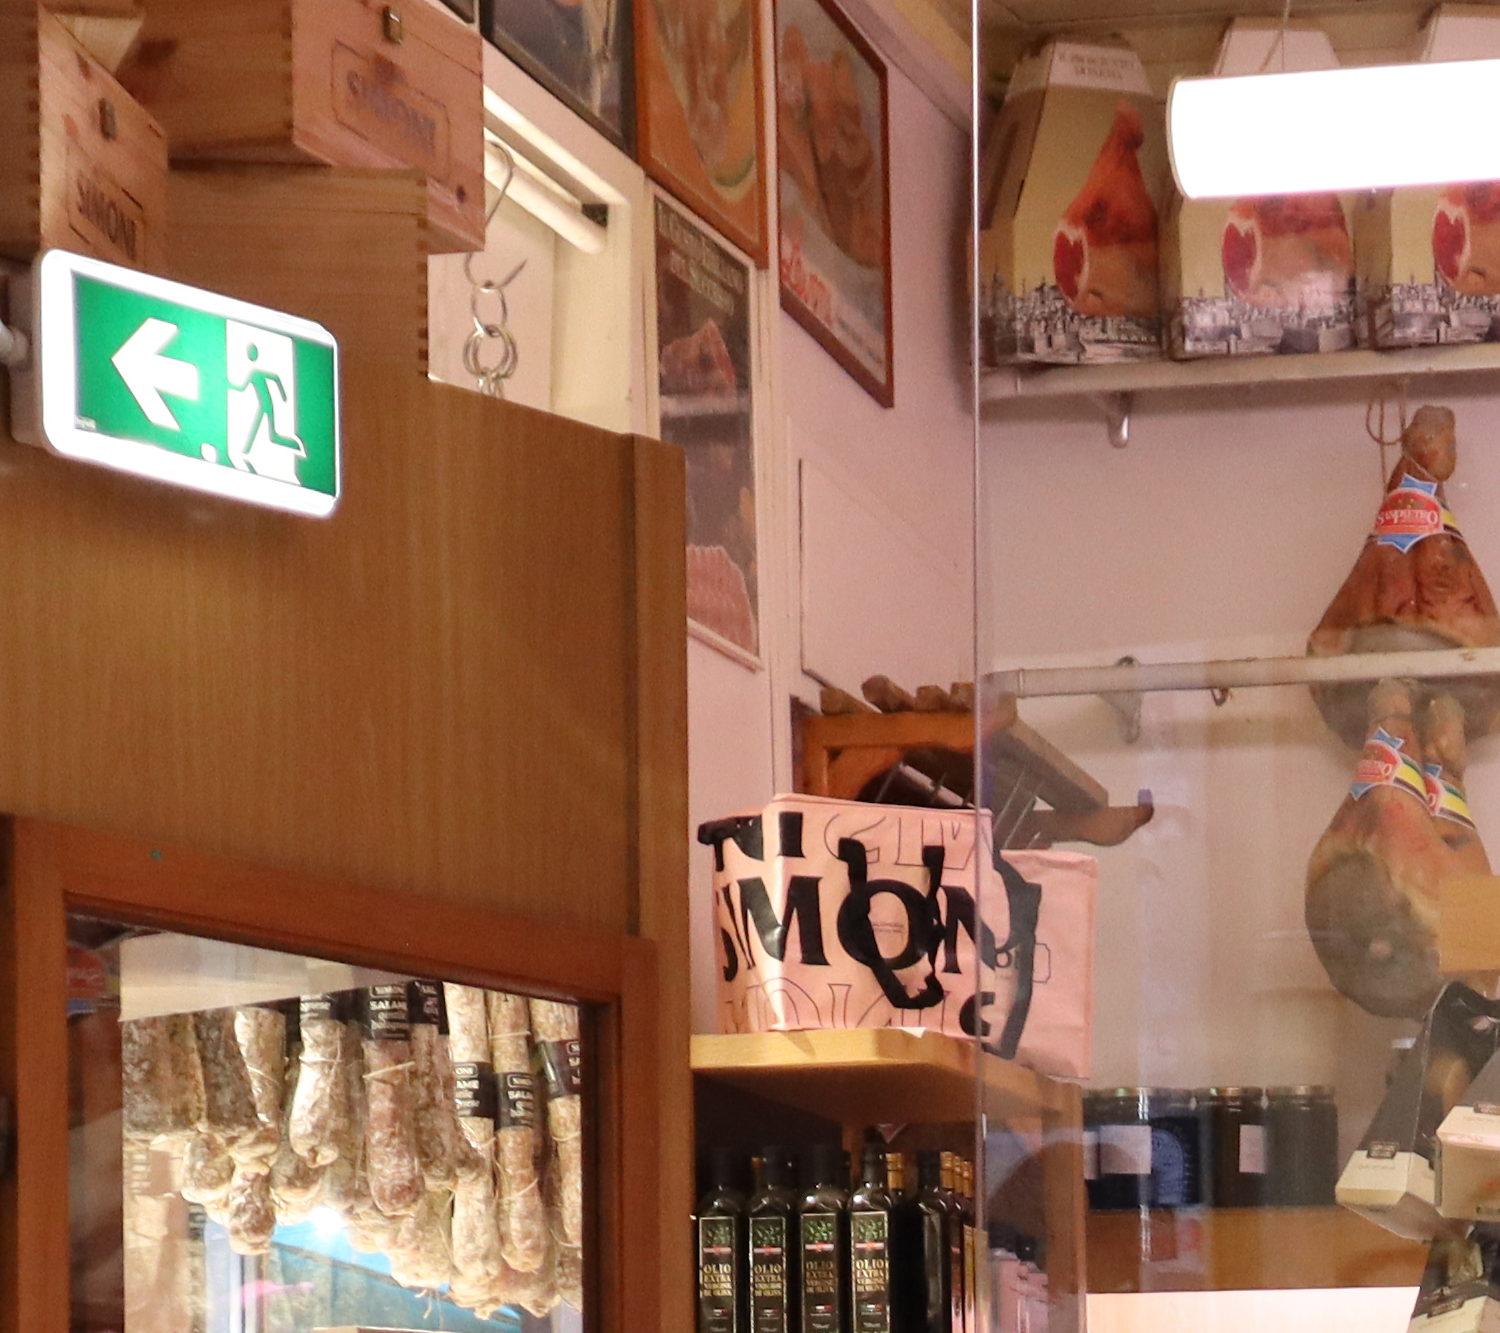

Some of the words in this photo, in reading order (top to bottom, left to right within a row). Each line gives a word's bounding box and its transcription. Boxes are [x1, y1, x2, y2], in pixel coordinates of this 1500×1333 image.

[703, 1263, 731, 1274] OLIO
[754, 1263, 782, 1274] OLIO
[806, 1261, 833, 1270] OLIO
[856, 1259, 884, 1269] OLIO
